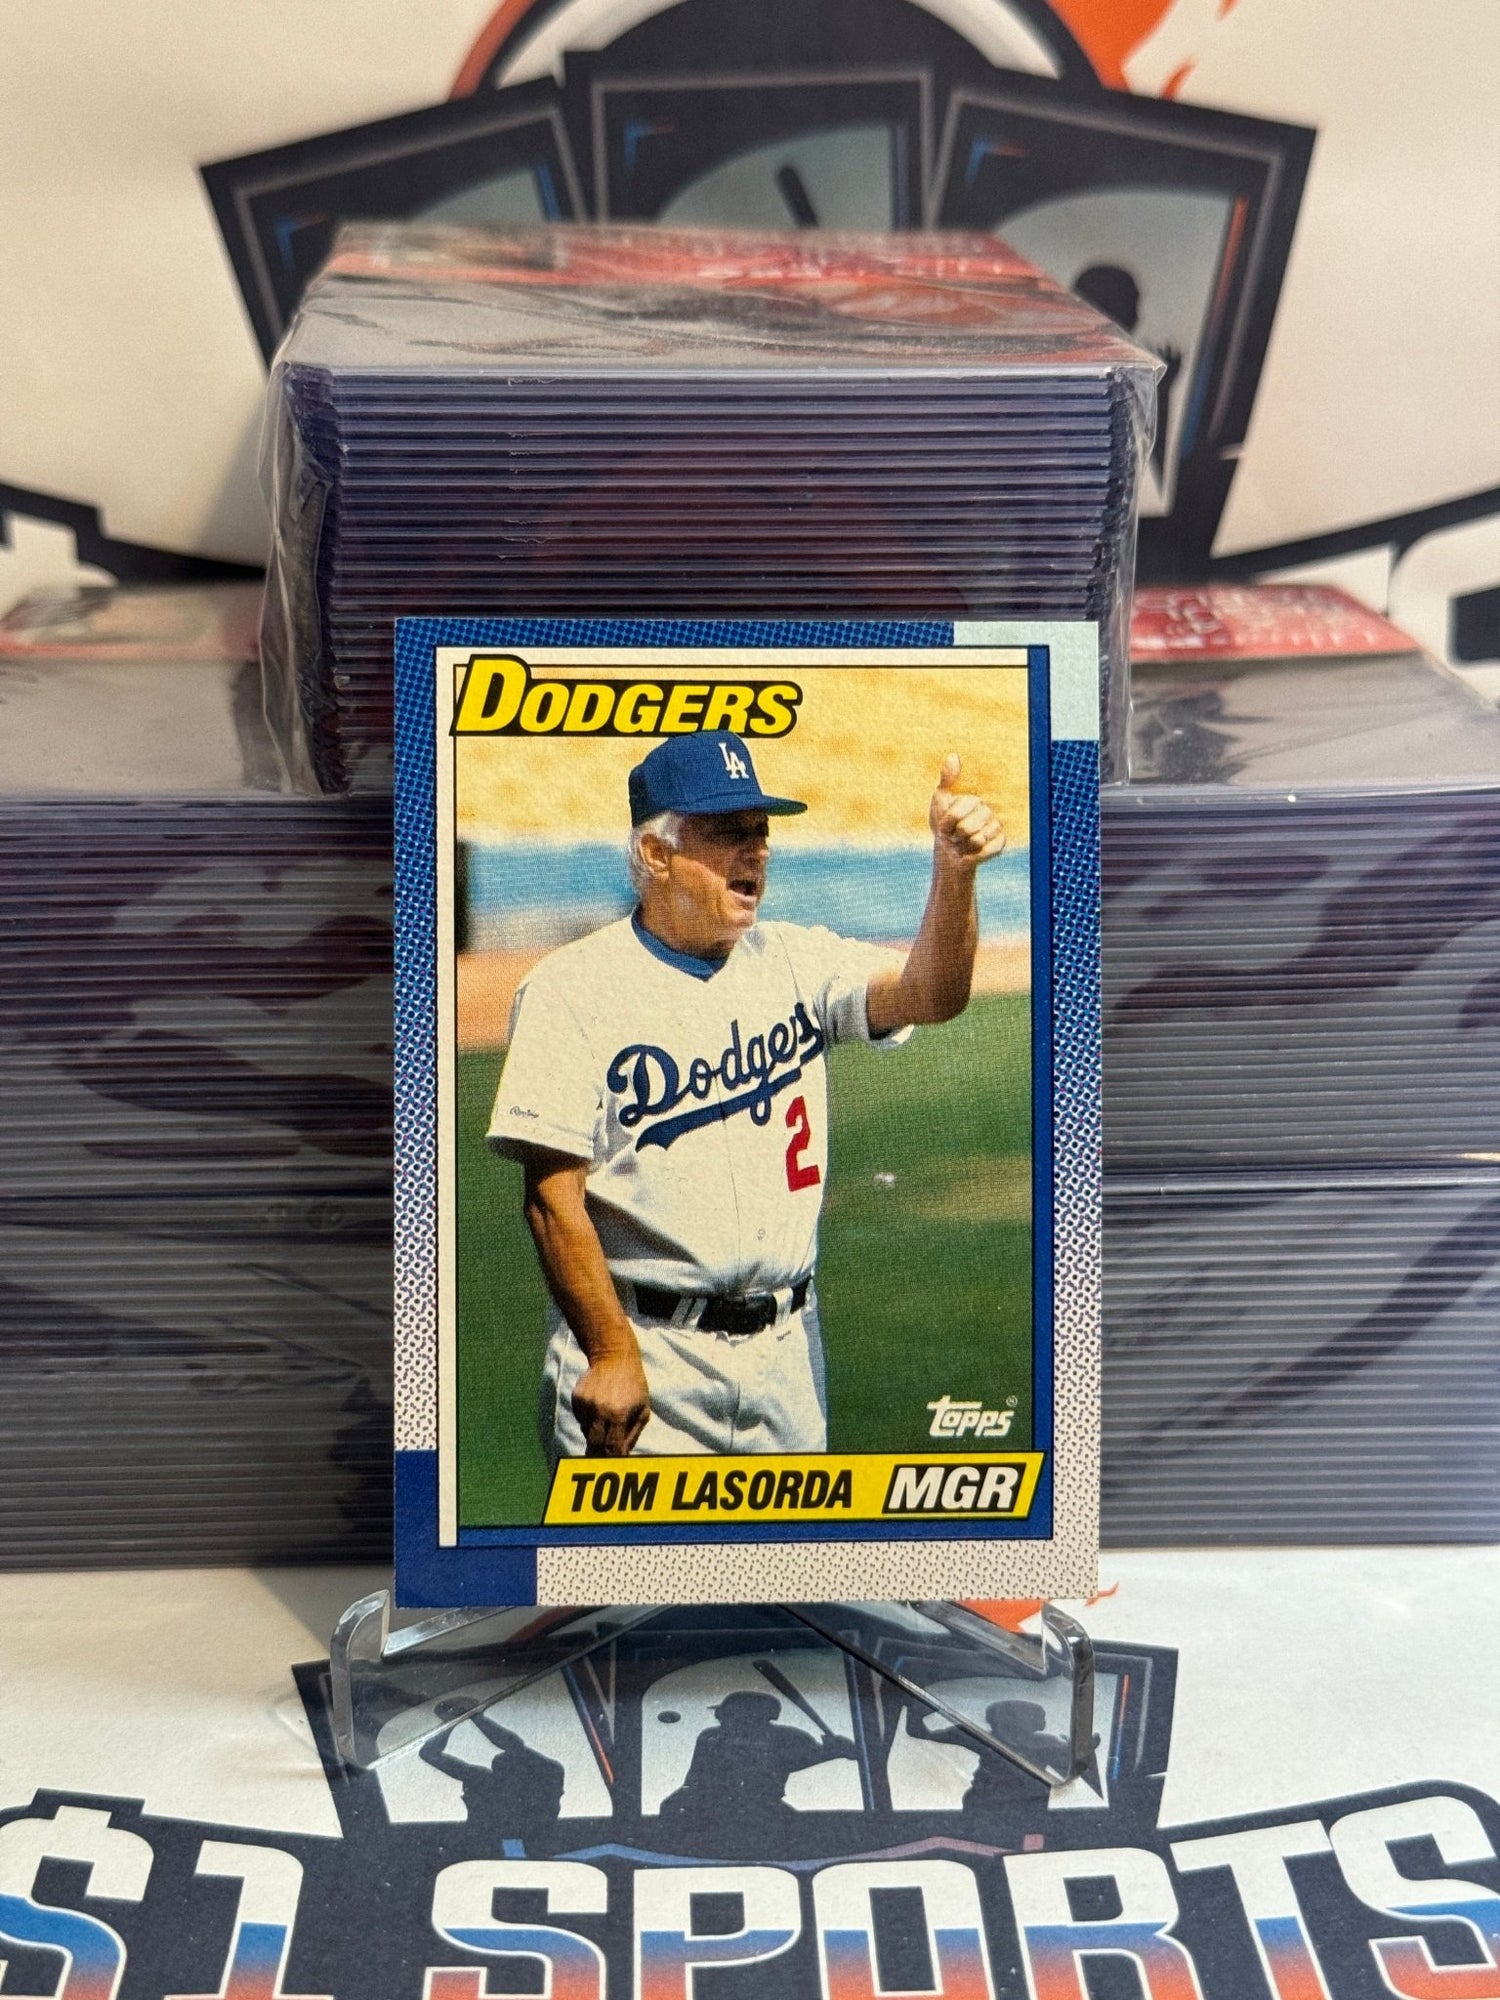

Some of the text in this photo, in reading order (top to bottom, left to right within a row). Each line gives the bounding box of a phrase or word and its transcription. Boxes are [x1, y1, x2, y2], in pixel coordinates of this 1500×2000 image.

[454, 657, 800, 736] DODGERS
[718, 741, 750, 780] LA
[785, 1094, 821, 1193] 2
[570, 1466, 1019, 1513] TOM LASORDA MGR
[422, 1795, 1500, 2000] SPORTS
